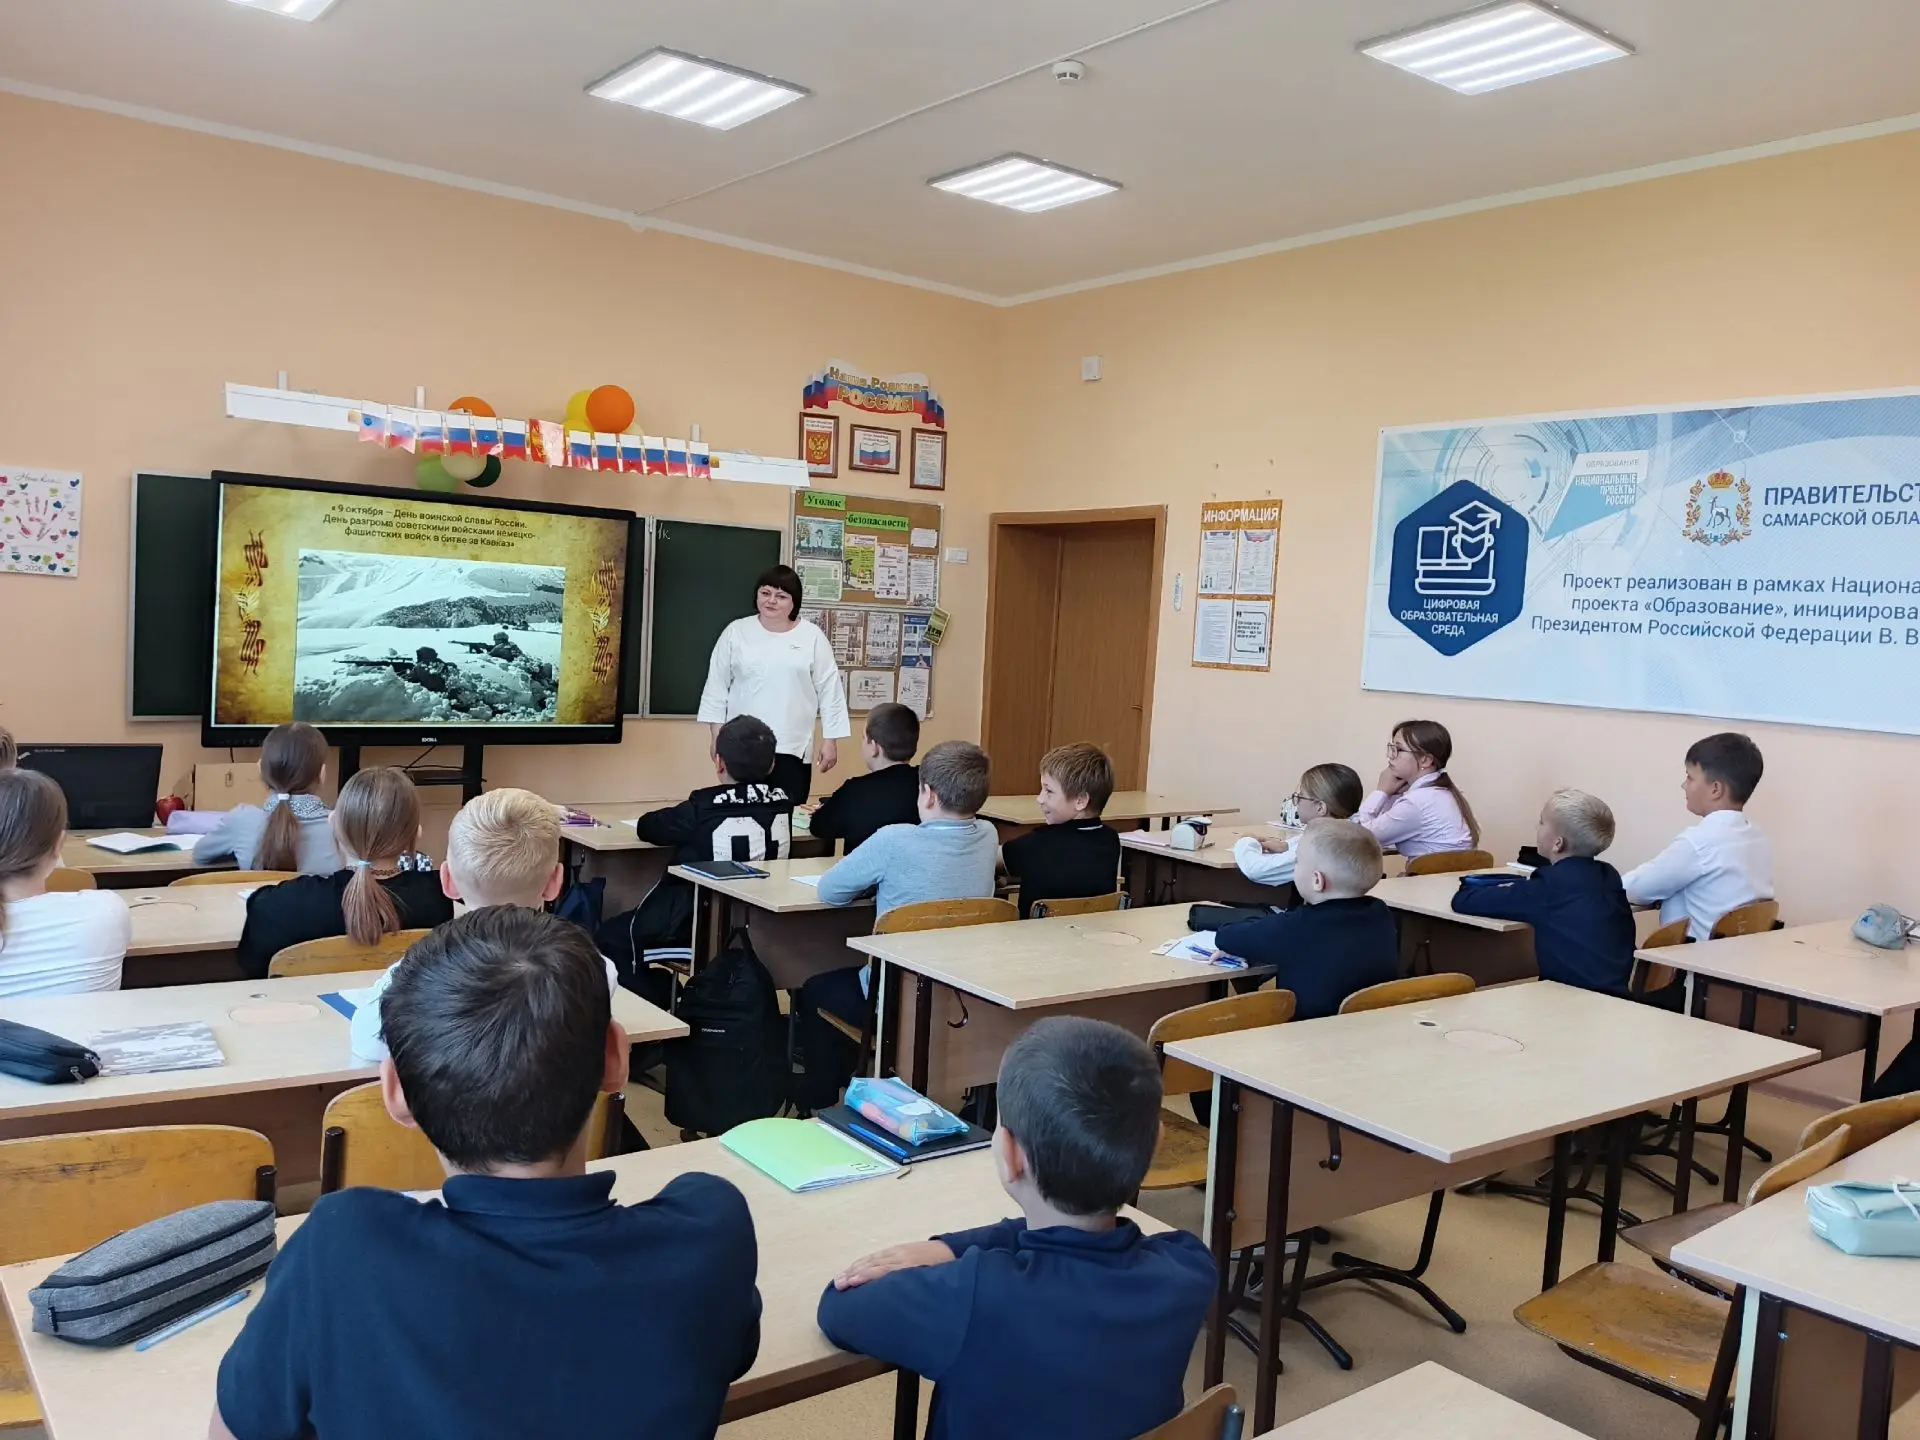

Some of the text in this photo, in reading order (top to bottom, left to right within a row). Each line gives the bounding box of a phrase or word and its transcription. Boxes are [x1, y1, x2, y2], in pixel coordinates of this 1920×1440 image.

[830, 366, 867, 387] Наша
[871, 377, 920, 393] Родина
[837, 384, 914, 411] РОССИЯ
[1575, 473, 1637, 487] НАЦИОНАЛЬНЫЕ
[1600, 484, 1636, 495] ПРОЕКТЫ
[807, 495, 842, 508] Уголок
[1605, 494, 1635, 506] РОССИИ
[346, 506, 383, 517] октября
[394, 509, 417, 519] День
[420, 513, 462, 522] воинской
[465, 516, 492, 525] славы
[494, 518, 527, 528] России.
[848, 514, 907, 528] безопасности
[1204, 507, 1279, 523] ИНФОРМАЦИЯ
[1762, 509, 1920, 527] САМАРСКОЙ ОБЛА
[323, 514, 535, 539] День разгрома советскими войсками немецко-
[344, 526, 402, 539] фашистских
[404, 532, 430, 541] войск
[441, 534, 467, 543] битве
[1563, 573, 1920, 597] Проект реализован в рамках Национа
[1423, 599, 1480, 610] ЦИФРОВАЯ
[1571, 596, 1919, 623] проекта «Образование», инициирова
[1400, 610, 1499, 623] ОБРАЗОВАТЕЛЬНАЯ
[1431, 624, 1466, 637] СРЕДА
[1531, 615, 1643, 635] Президентом
[1648, 619, 1755, 638] Российской
[1761, 623, 1872, 646] Федерации
[1879, 627, 1898, 645] В.
